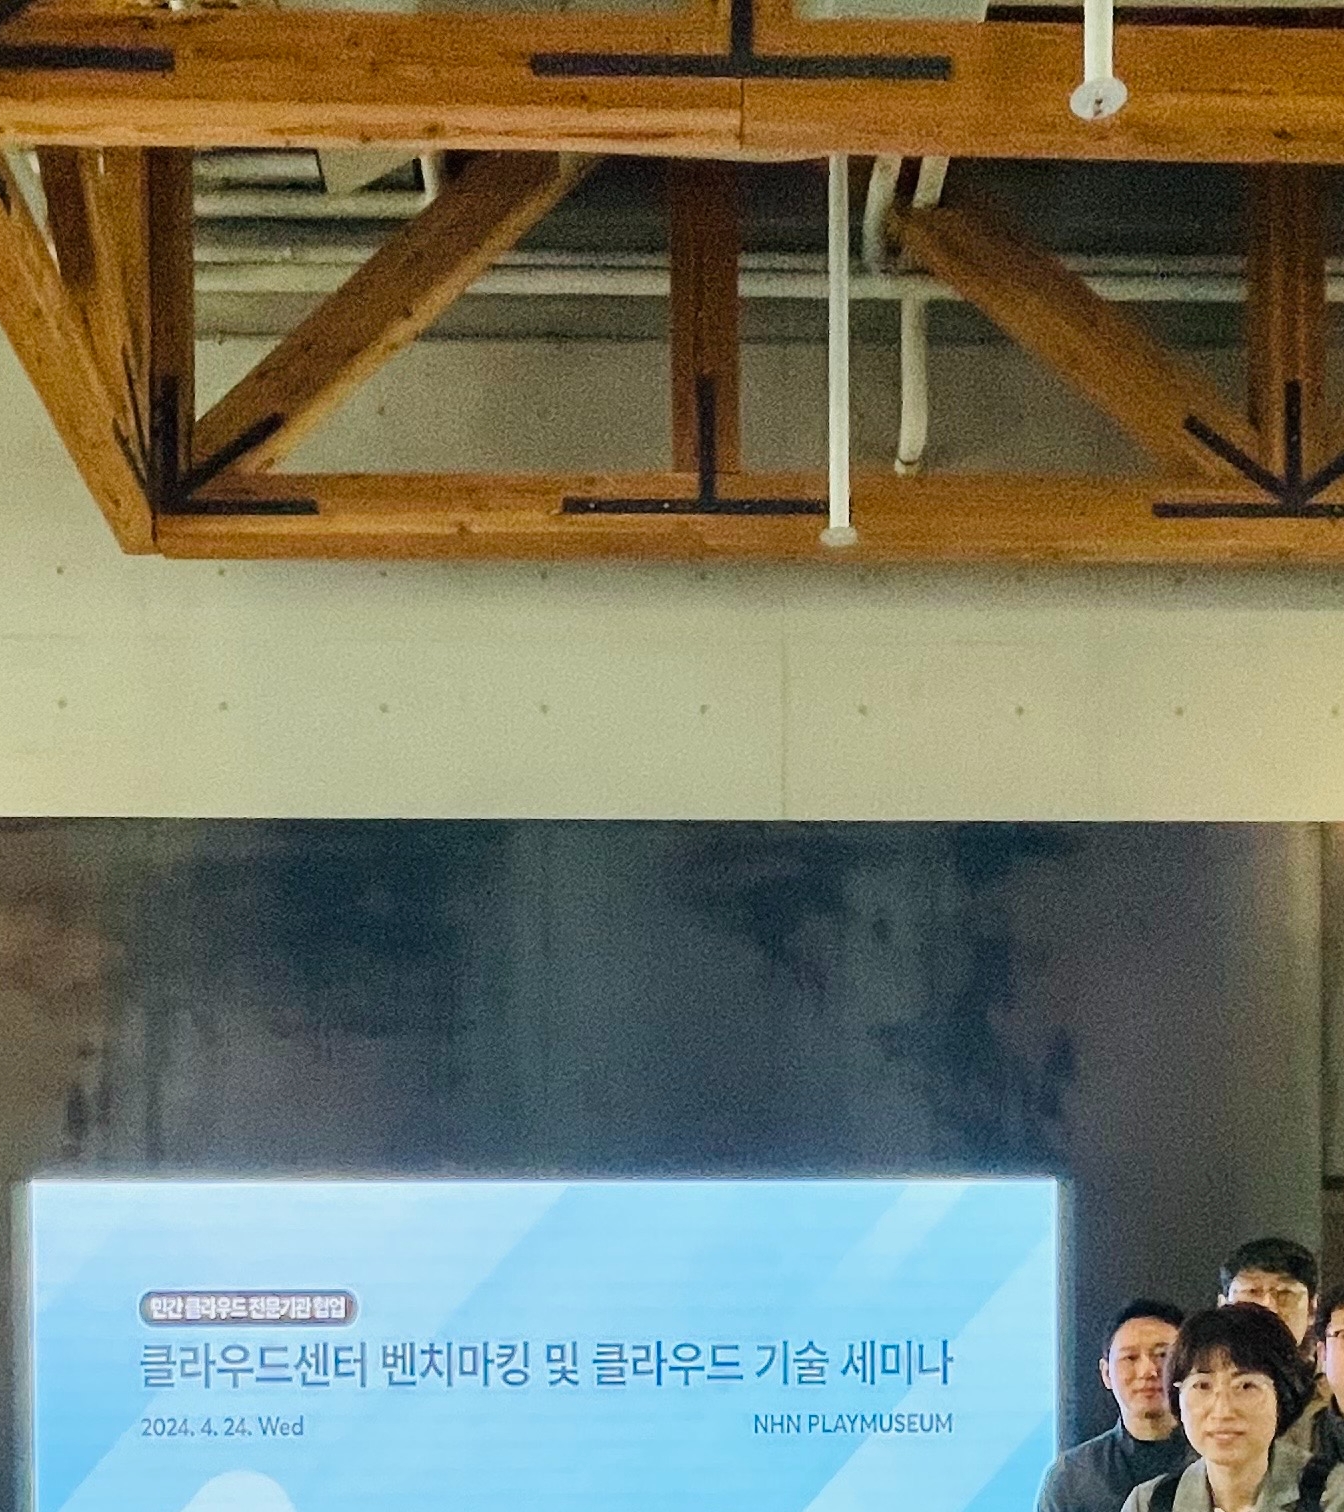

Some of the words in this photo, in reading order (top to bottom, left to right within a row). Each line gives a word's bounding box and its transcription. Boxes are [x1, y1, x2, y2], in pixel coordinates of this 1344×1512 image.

[150, 1296, 183, 1320] 민간
[185, 1296, 248, 1320] 클라우드
[249, 1296, 312, 1320] 전문기관
[140, 1341, 367, 1389] 클라우드센터
[381, 1341, 531, 1388] 벤치마킹
[545, 1340, 579, 1387] 및
[592, 1340, 744, 1386] 클라우드
[755, 1340, 830, 1386] 기술
[840, 1339, 955, 1386] 세미나
[141, 1417, 195, 1437] 2024.
[200, 1417, 218, 1437] 4.
[224, 1417, 253, 1437] 24.
[258, 1415, 304, 1437] Wed
[754, 1413, 802, 1434] NHN
[808, 1413, 954, 1434] PLAYMUSEUM
